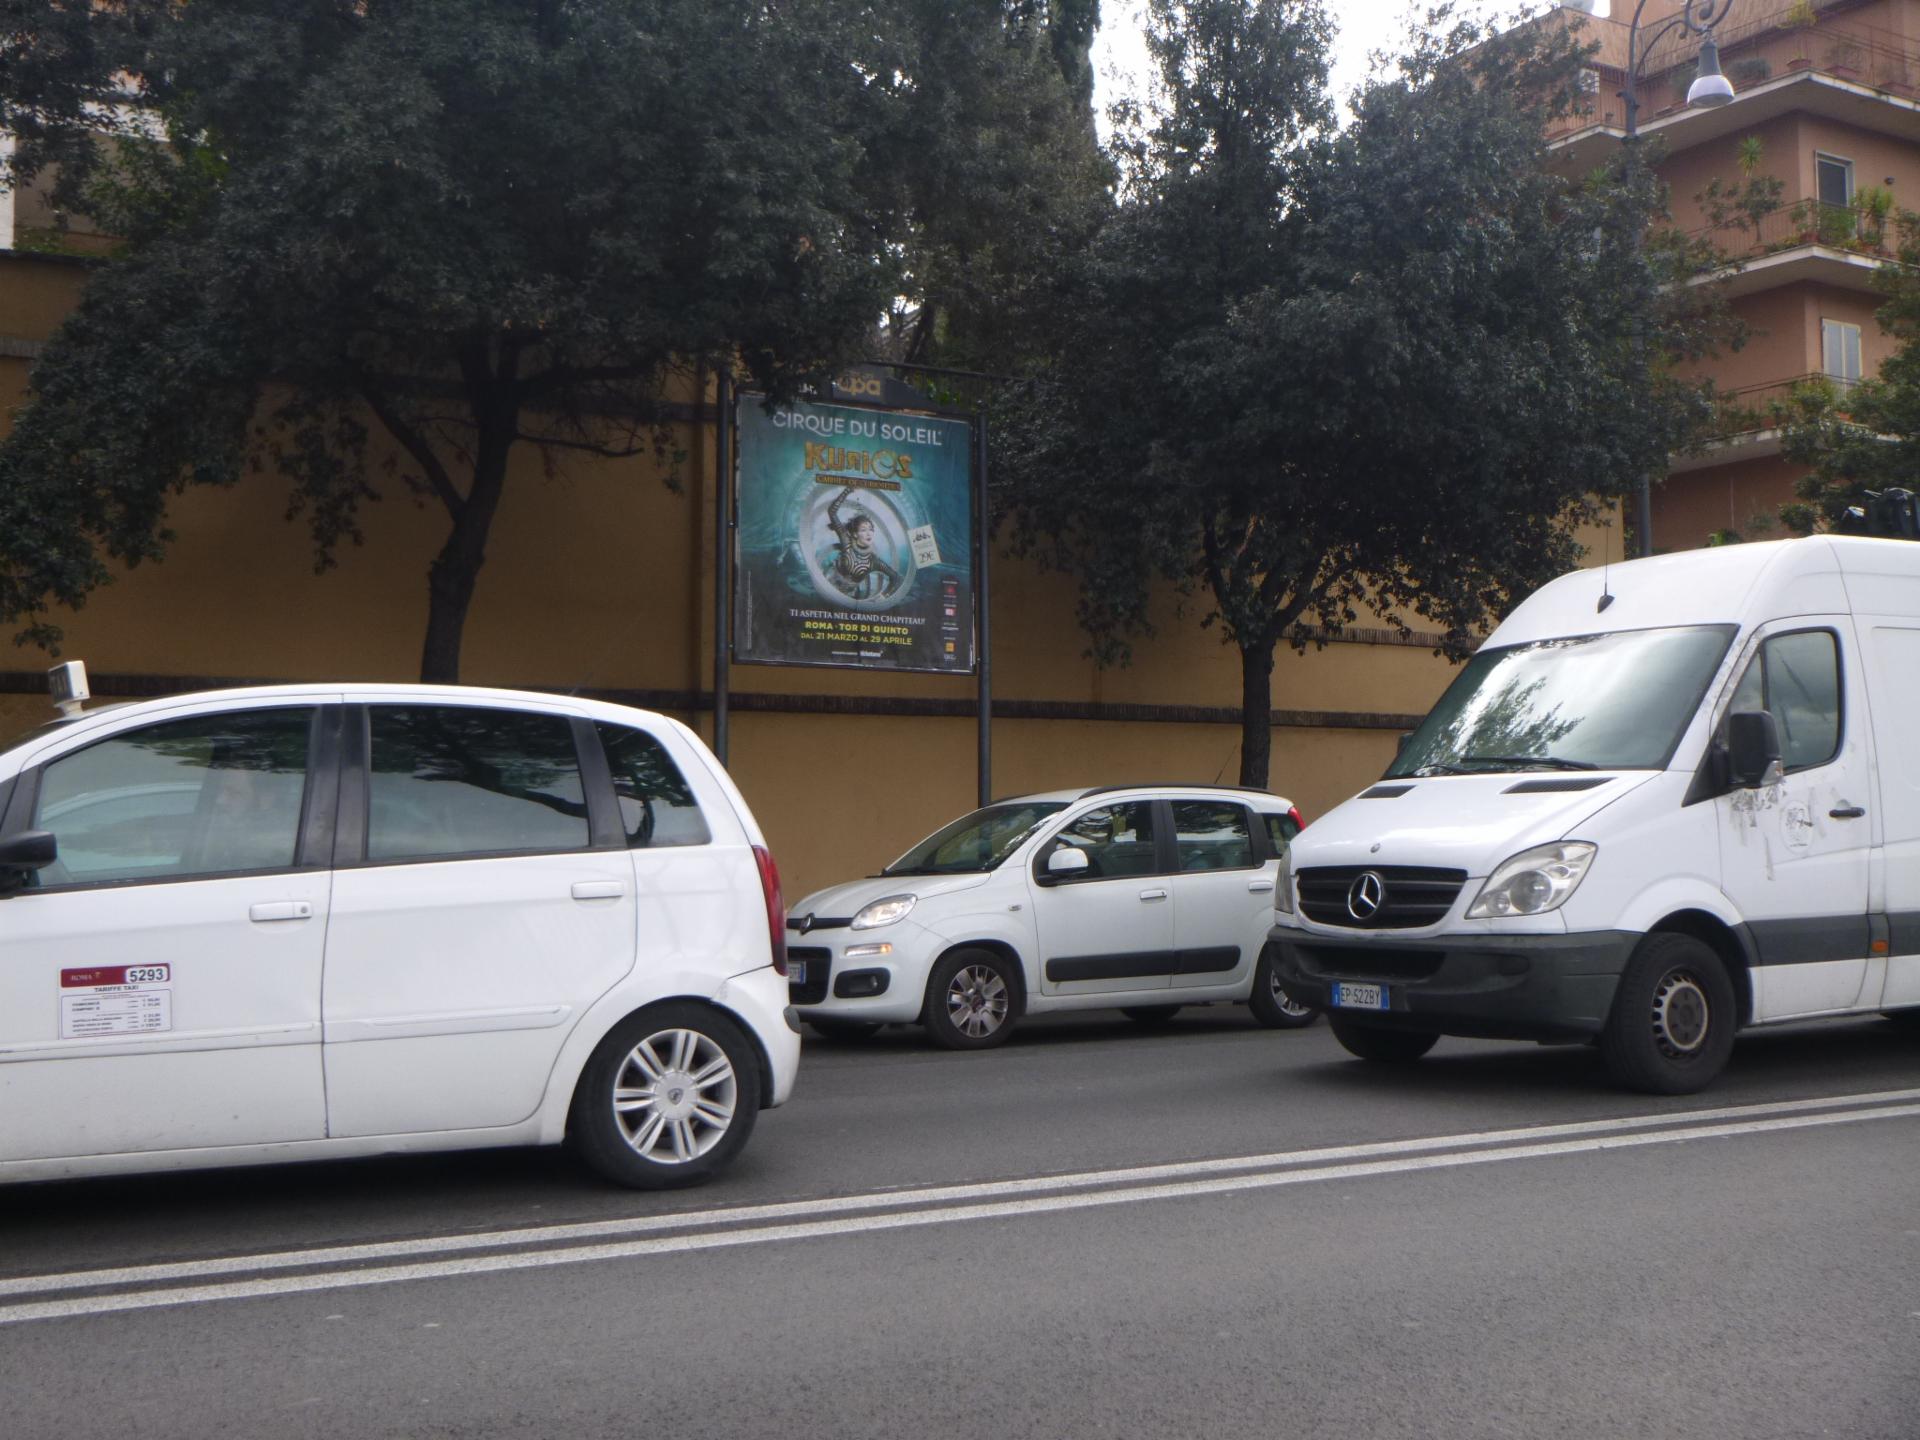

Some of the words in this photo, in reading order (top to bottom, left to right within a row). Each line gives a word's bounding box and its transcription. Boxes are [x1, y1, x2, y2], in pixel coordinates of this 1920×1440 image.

[772, 411, 845, 437] CIRQUE
[850, 420, 876, 438] DU
[881, 423, 942, 446] SOLEIL
[790, 608, 799, 617] TI
[800, 609, 832, 619] ASPETTA
[833, 612, 849, 621] NEL
[850, 613, 879, 622] GRAND
[805, 621, 833, 630] ROMA
[838, 623, 858, 632] TOR
[861, 624, 870, 633] DI
[873, 625, 909, 635] QUINTO
[800, 632, 814, 640] DAL
[816, 632, 825, 640] 21
[827, 632, 858, 642] MARZO
[883, 636, 913, 646] APRILE
[130, 968, 163, 982] 5293
